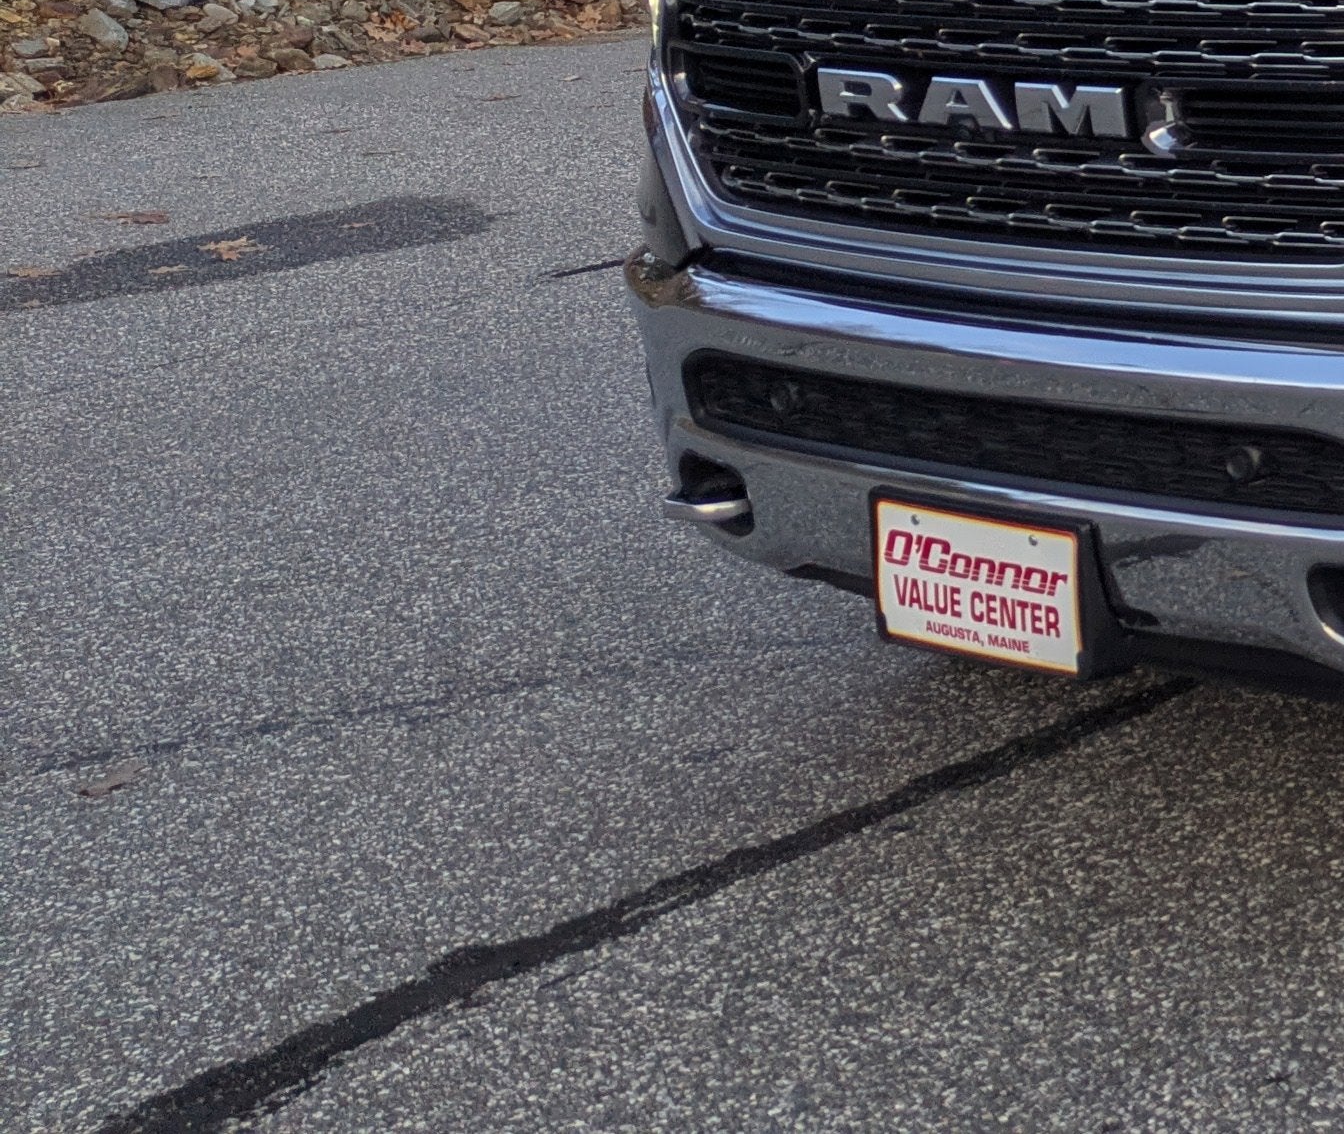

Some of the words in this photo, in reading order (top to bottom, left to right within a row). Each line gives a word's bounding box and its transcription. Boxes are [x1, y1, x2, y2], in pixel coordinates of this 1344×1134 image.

[817, 66, 1129, 139] RAM
[884, 528, 1068, 597] O'Connor
[893, 573, 962, 619] VALUE
[970, 591, 1061, 639] CENTER
[925, 619, 985, 647] AUGUSTA,
[987, 634, 1031, 654] MAINE
